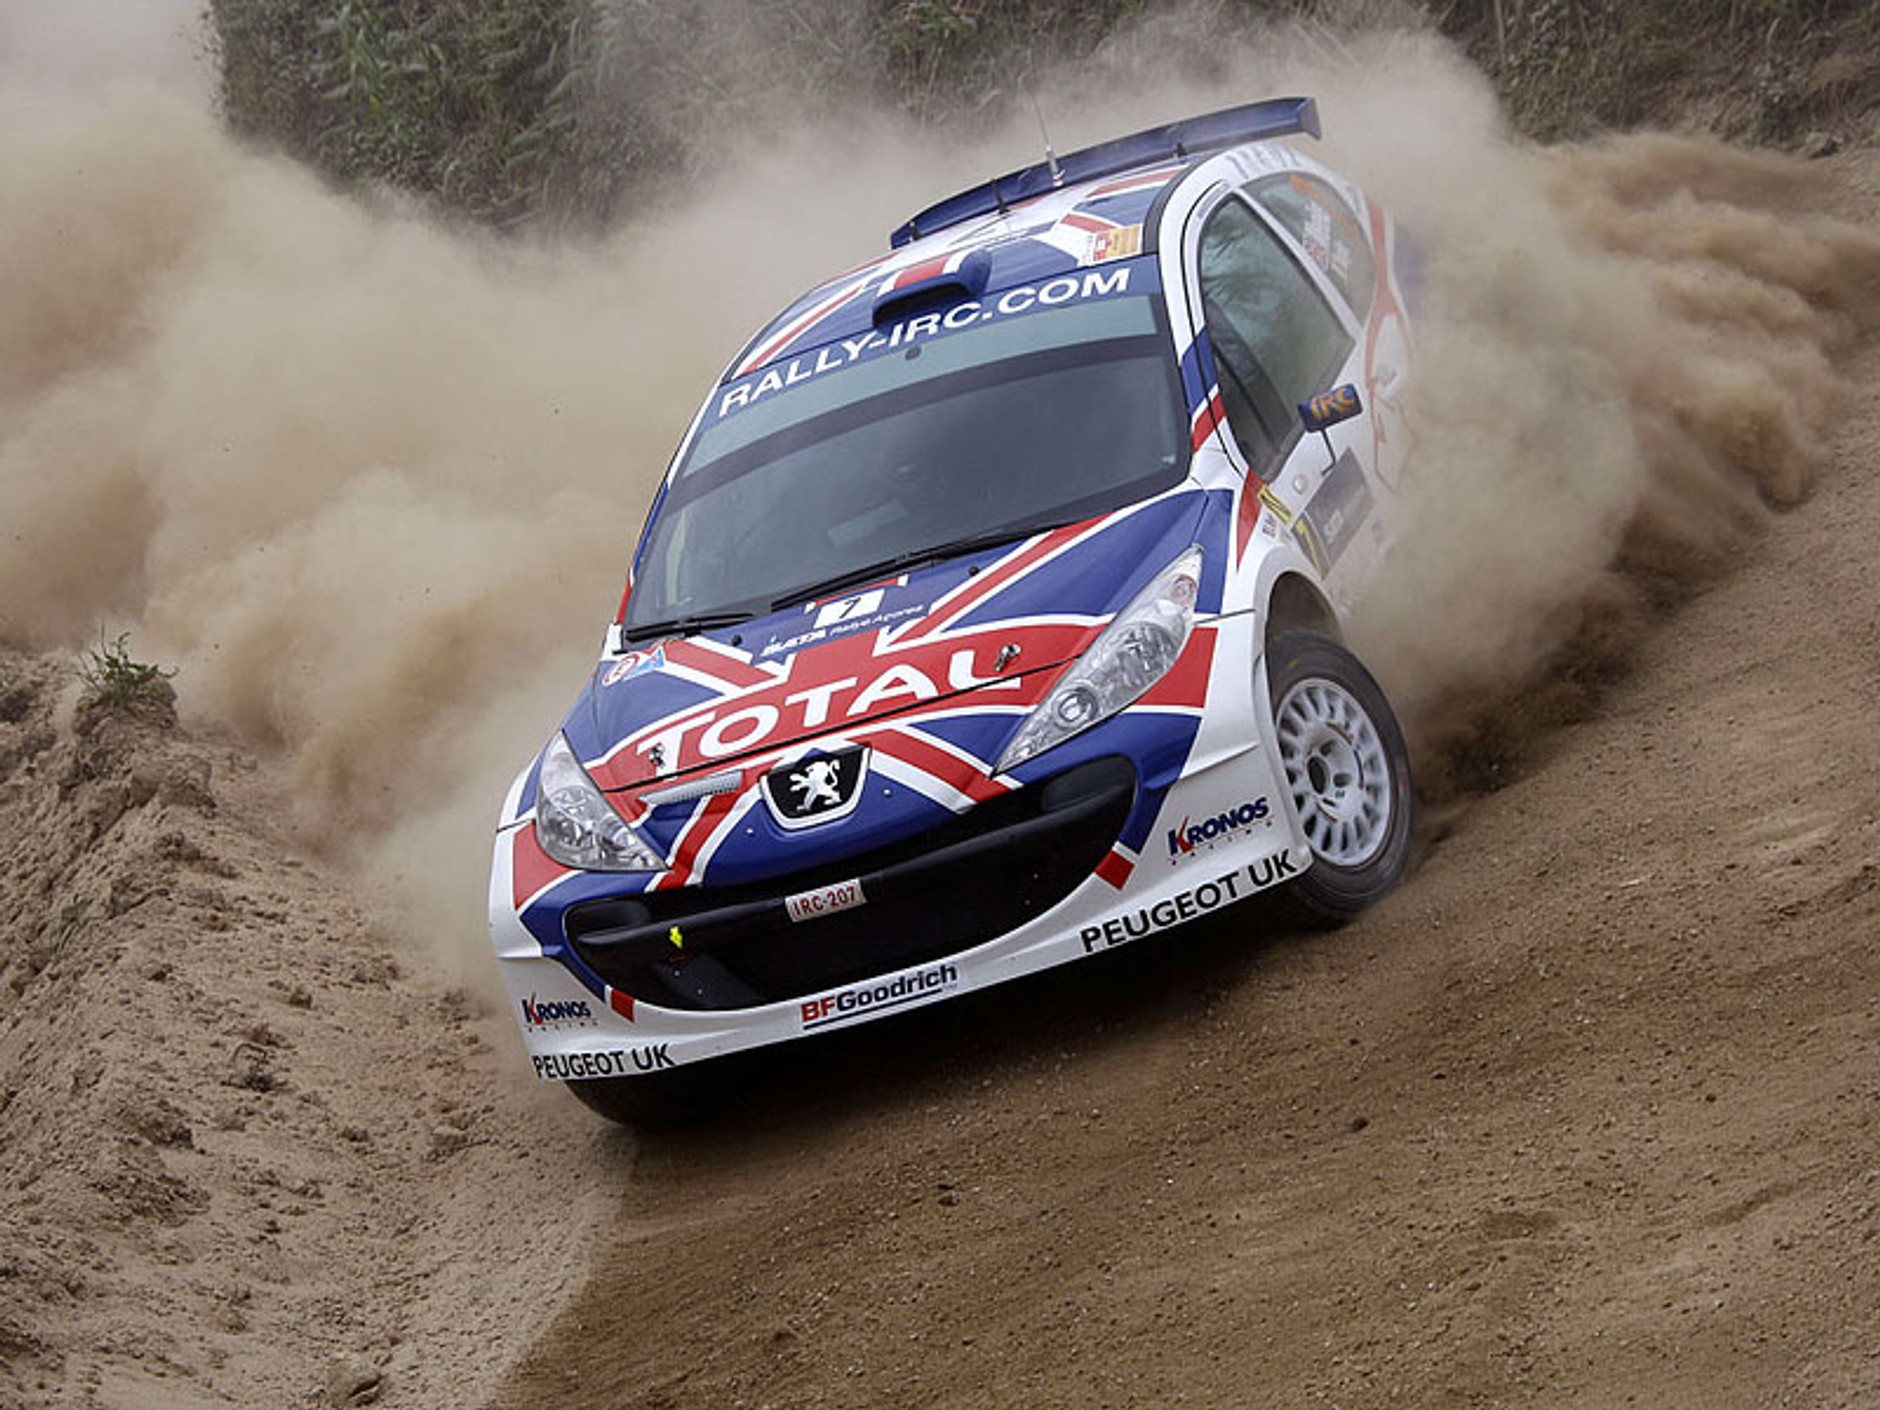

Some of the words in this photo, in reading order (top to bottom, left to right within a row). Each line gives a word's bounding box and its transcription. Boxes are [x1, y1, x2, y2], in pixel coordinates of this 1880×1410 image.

[719, 267, 1130, 417] RALLY-IRC.COM
[839, 596, 862, 619] 7
[637, 651, 1022, 782] TOTAL
[1167, 796, 1270, 857] KRONOS
[793, 886, 857, 917] IRC-207
[1080, 871, 1240, 953] PEUGEOT
[1248, 848, 1298, 887] UK
[521, 992, 592, 1025] KRONOS
[801, 964, 958, 1022] BFGoodrich
[532, 1050, 625, 1079] PEUGEOT
[632, 1043, 676, 1071] UK
